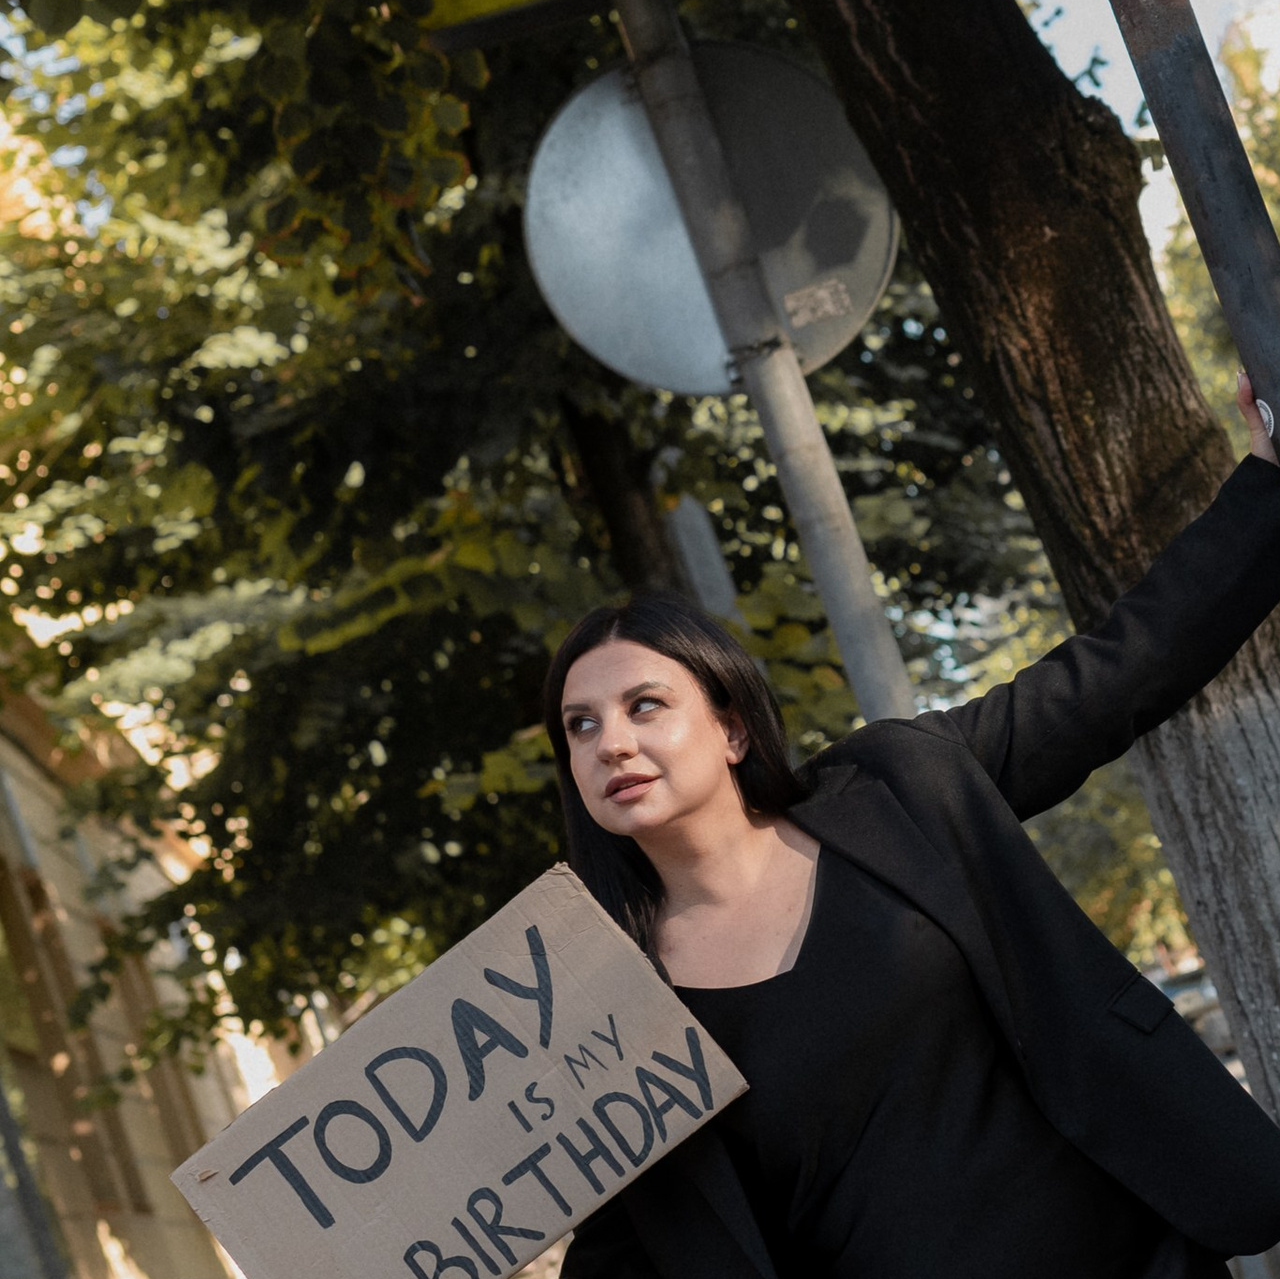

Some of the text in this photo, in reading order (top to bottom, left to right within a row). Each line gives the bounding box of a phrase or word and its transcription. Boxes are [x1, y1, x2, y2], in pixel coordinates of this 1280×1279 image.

[229, 925, 554, 1229] TODAY
[507, 1014, 625, 1133] IS MY
